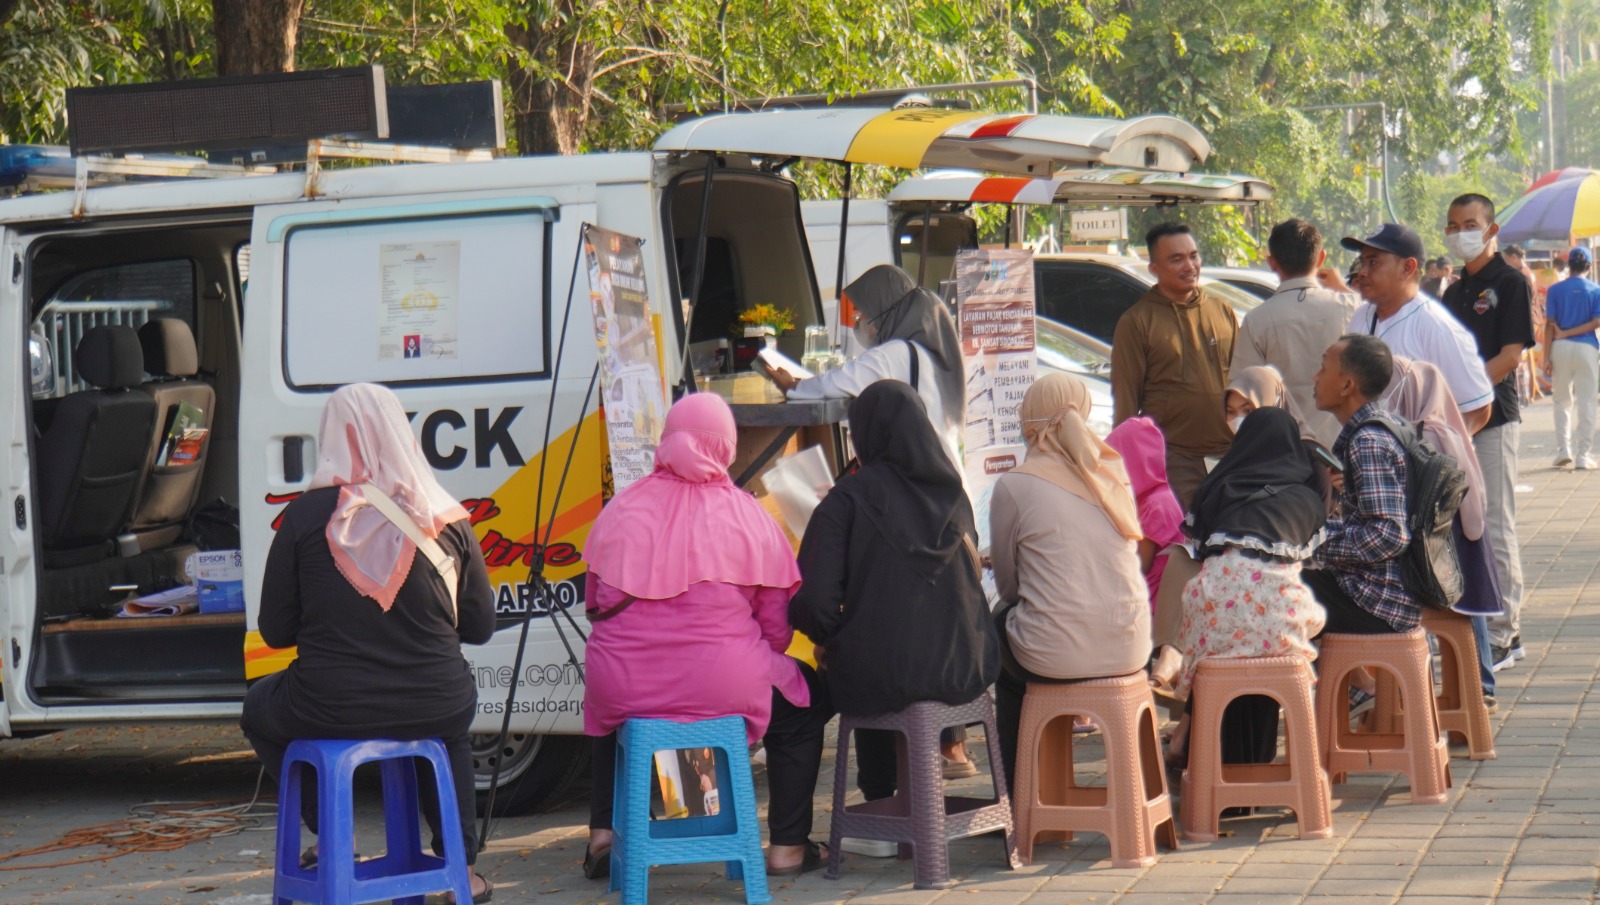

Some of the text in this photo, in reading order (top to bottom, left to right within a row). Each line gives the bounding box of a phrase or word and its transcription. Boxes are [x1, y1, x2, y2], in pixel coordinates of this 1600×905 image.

[1074, 219, 1118, 231] TOILET
[963, 308, 1033, 322] LAYANAN PAJAK KENDARAAN
[972, 322, 1022, 335] BERMOTOR TAHUNAN
[980, 337, 999, 348] SAMSAT
[999, 335, 1025, 347] SIDOARJO
[998, 360, 1029, 372] MELAYANI
[994, 375, 1035, 387] PEMBAYARAN
[1005, 391, 1024, 401] PAJAK
[405, 406, 526, 471] CK
[985, 459, 1015, 472] Persyaratan
[199, 555, 226, 563] EPSON
